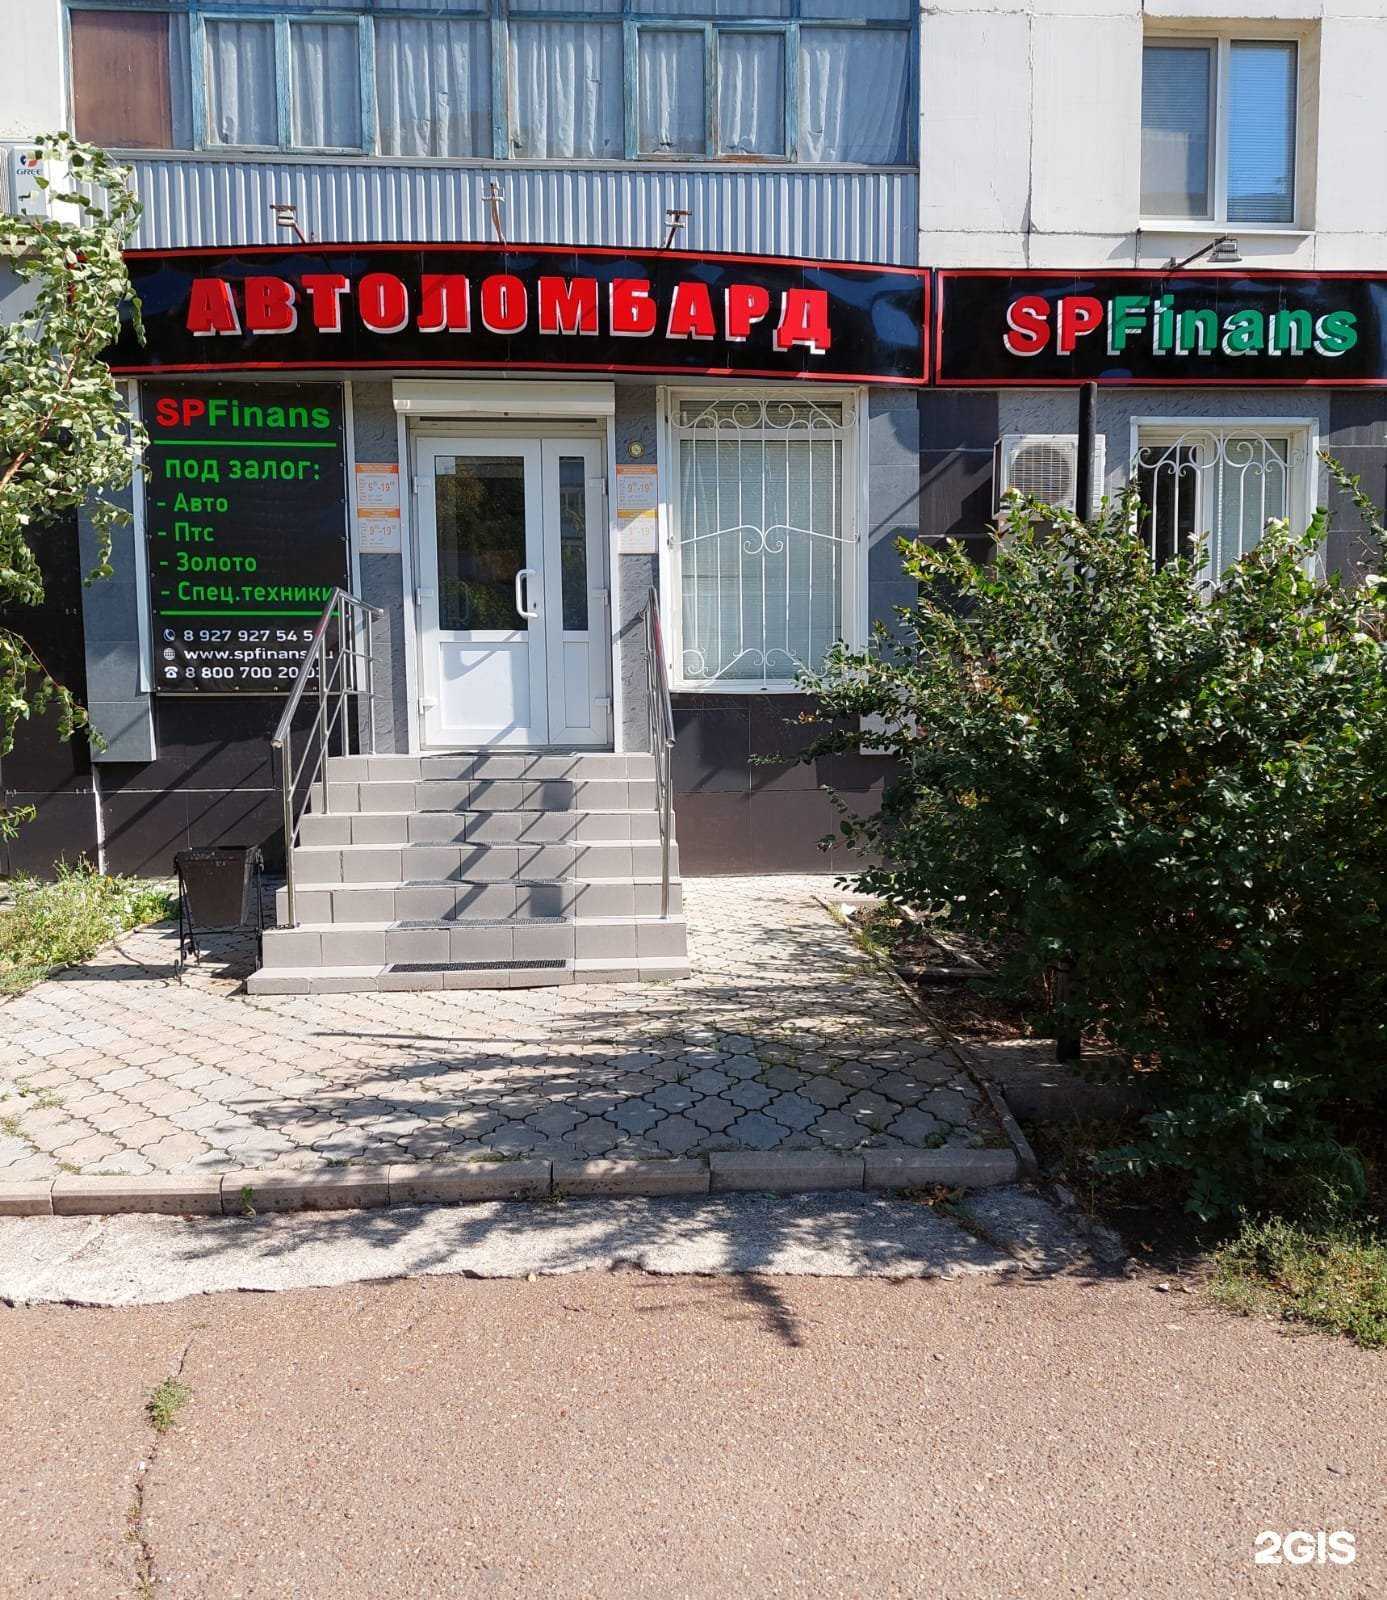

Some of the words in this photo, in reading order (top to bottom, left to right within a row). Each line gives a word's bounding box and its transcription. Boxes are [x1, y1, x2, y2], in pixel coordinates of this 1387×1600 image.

[186, 272, 832, 355] АВТОЛОМБАРД
[1003, 294, 1358, 357] SPFinans
[156, 397, 331, 428] SPFinans
[165, 458, 220, 483] под
[228, 458, 321, 481] залог:
[173, 492, 228, 513] Авто
[174, 522, 215, 542] Птс
[176, 552, 257, 572] Золото
[178, 581, 333, 604] Спец.техники
[183, 630, 194, 642] 8
[200, 630, 232, 642] 927
[238, 630, 270, 642] 927
[276, 630, 298, 642] 54
[185, 667, 196, 679] 8
[201, 667, 235, 679] 800
[240, 667, 272, 679] 700
[278, 667, 299, 679] 20
